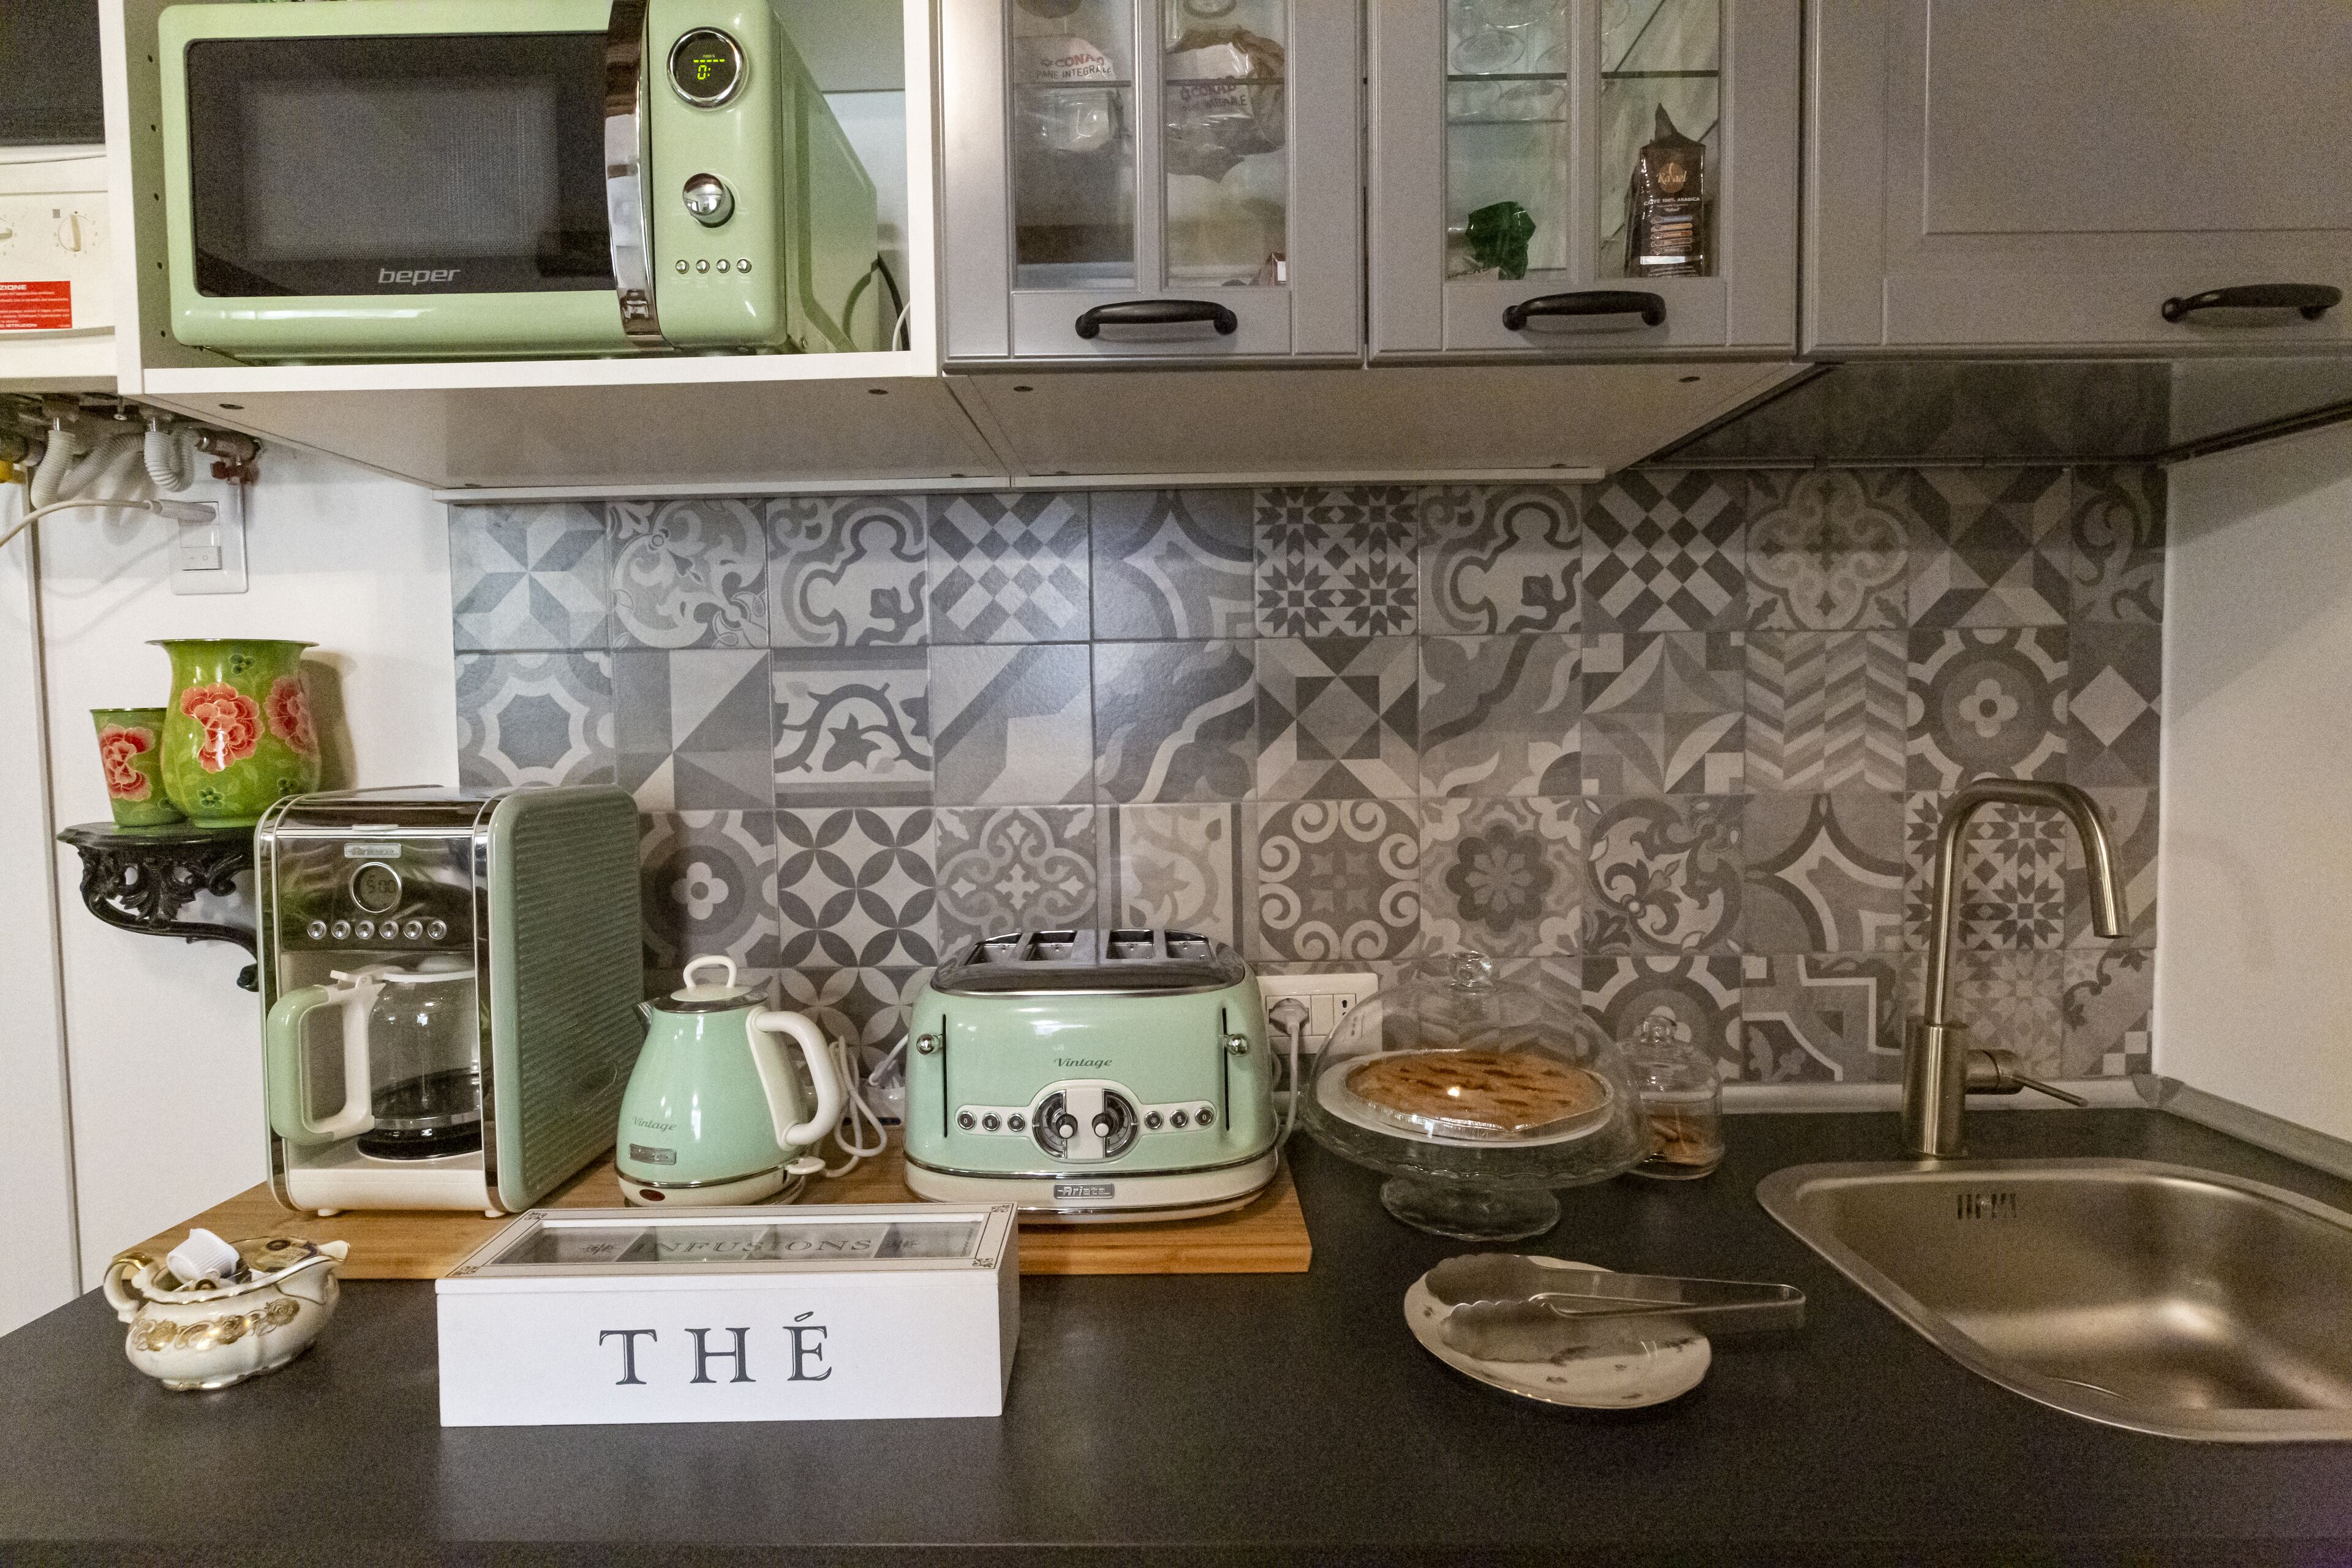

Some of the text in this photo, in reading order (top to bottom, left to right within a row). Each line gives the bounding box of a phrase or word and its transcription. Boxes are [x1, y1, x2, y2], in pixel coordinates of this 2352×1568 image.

[378, 268, 461, 286] beper
[1054, 1057, 1113, 1069] Vintage
[632, 1116, 677, 1133] Vintage
[599, 1311, 832, 1385] THÉ
